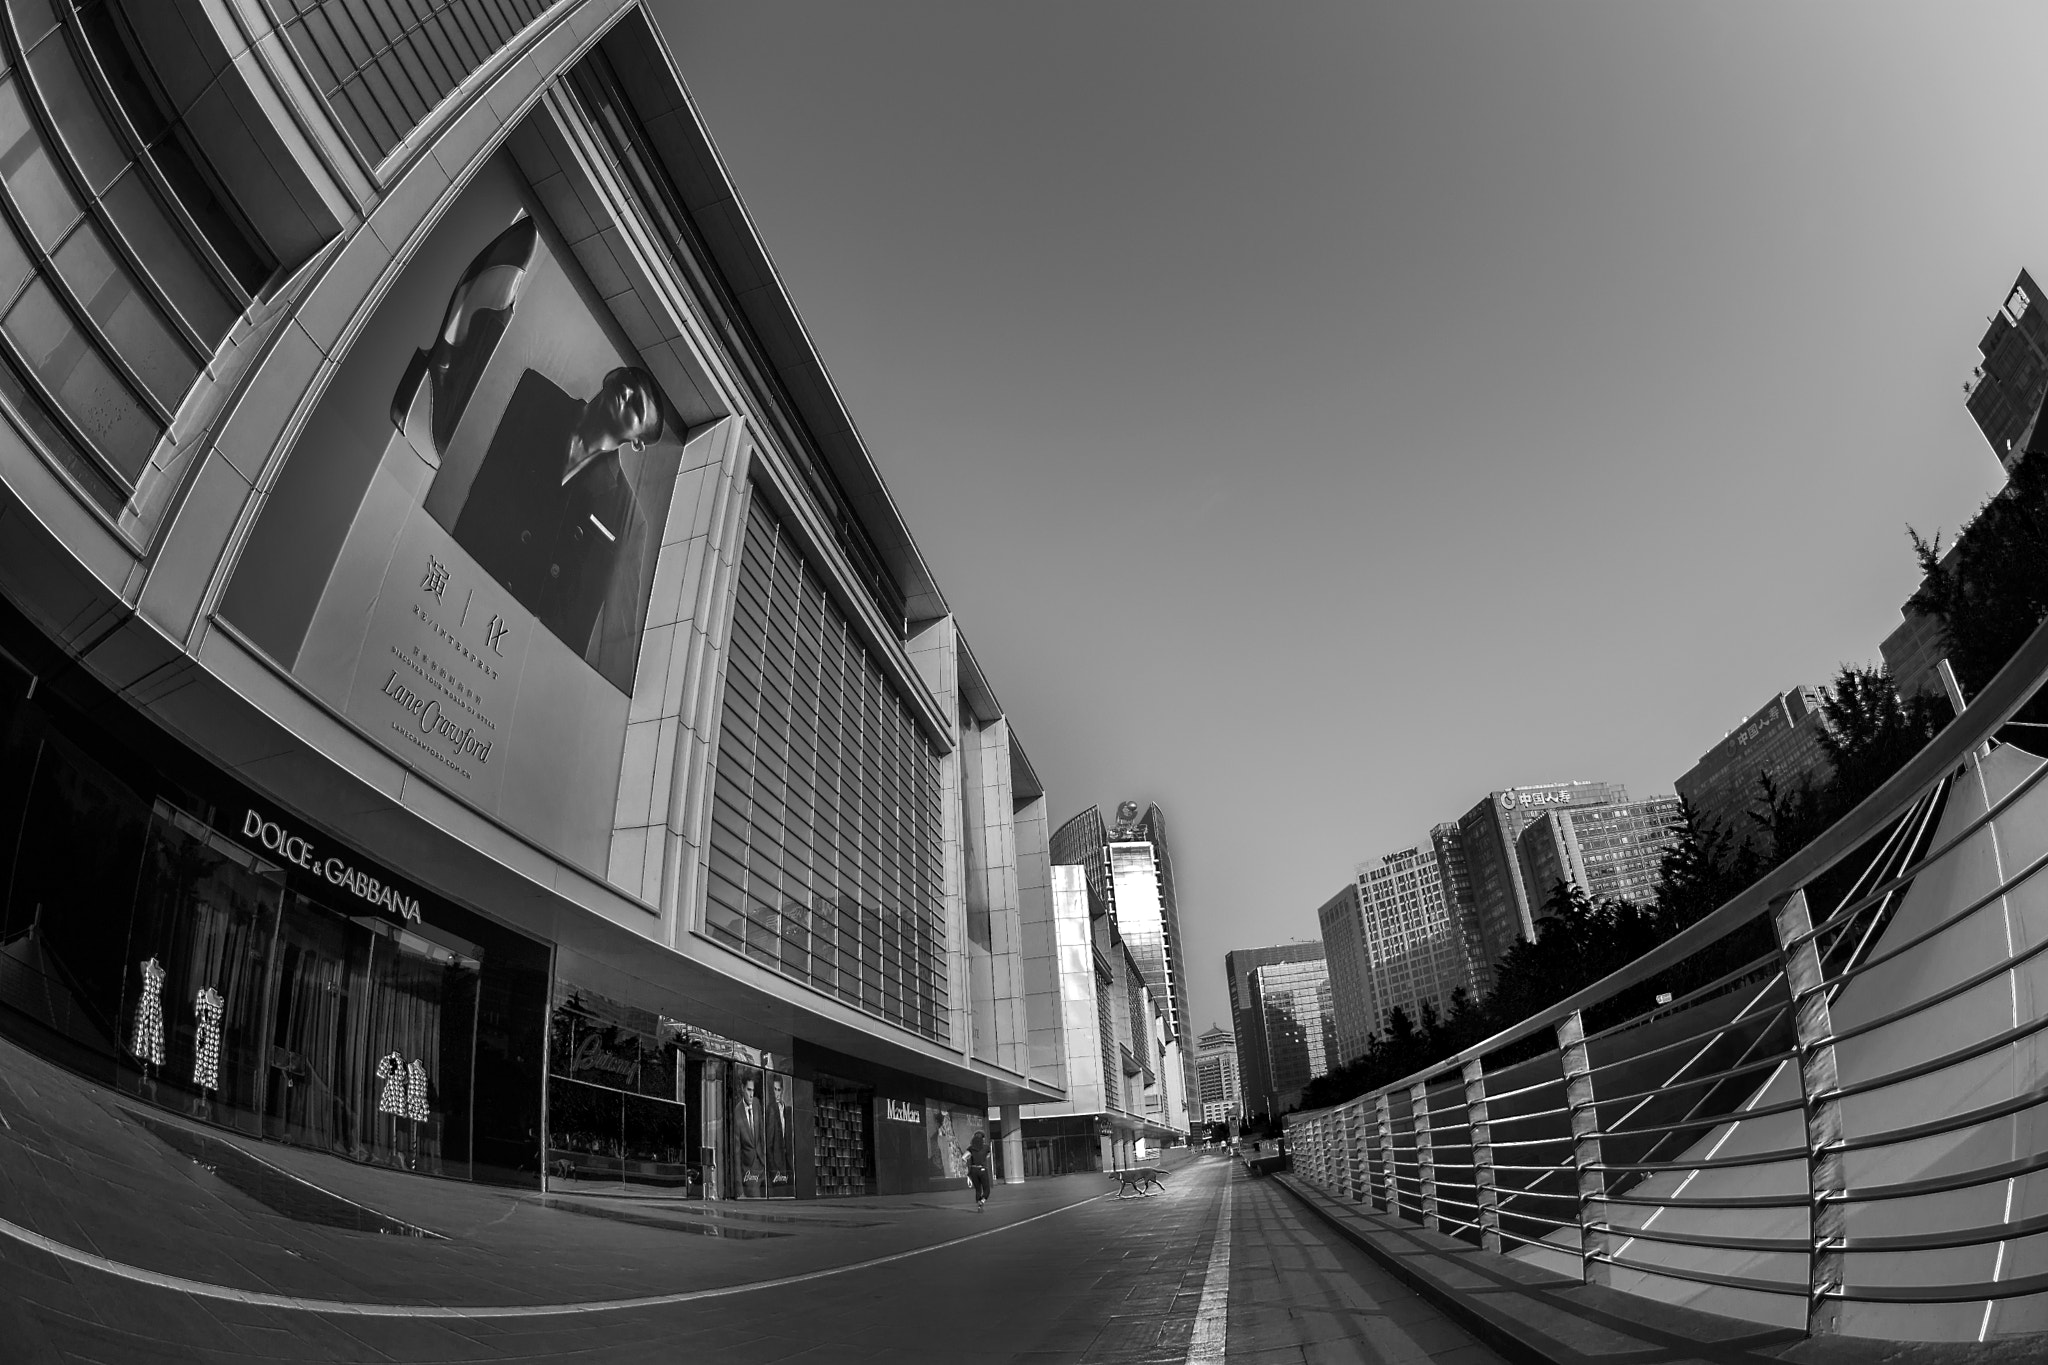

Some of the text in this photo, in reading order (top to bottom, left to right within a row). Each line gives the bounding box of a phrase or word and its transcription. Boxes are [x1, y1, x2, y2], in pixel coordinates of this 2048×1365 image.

[413, 604, 499, 681] RE/INTERPRET
[420, 554, 510, 658] 演 化
[1738, 706, 1779, 746] 中国人寿
[1518, 790, 1571, 808] 中国人寿
[242, 809, 422, 925] DOLCE & GABBANA
